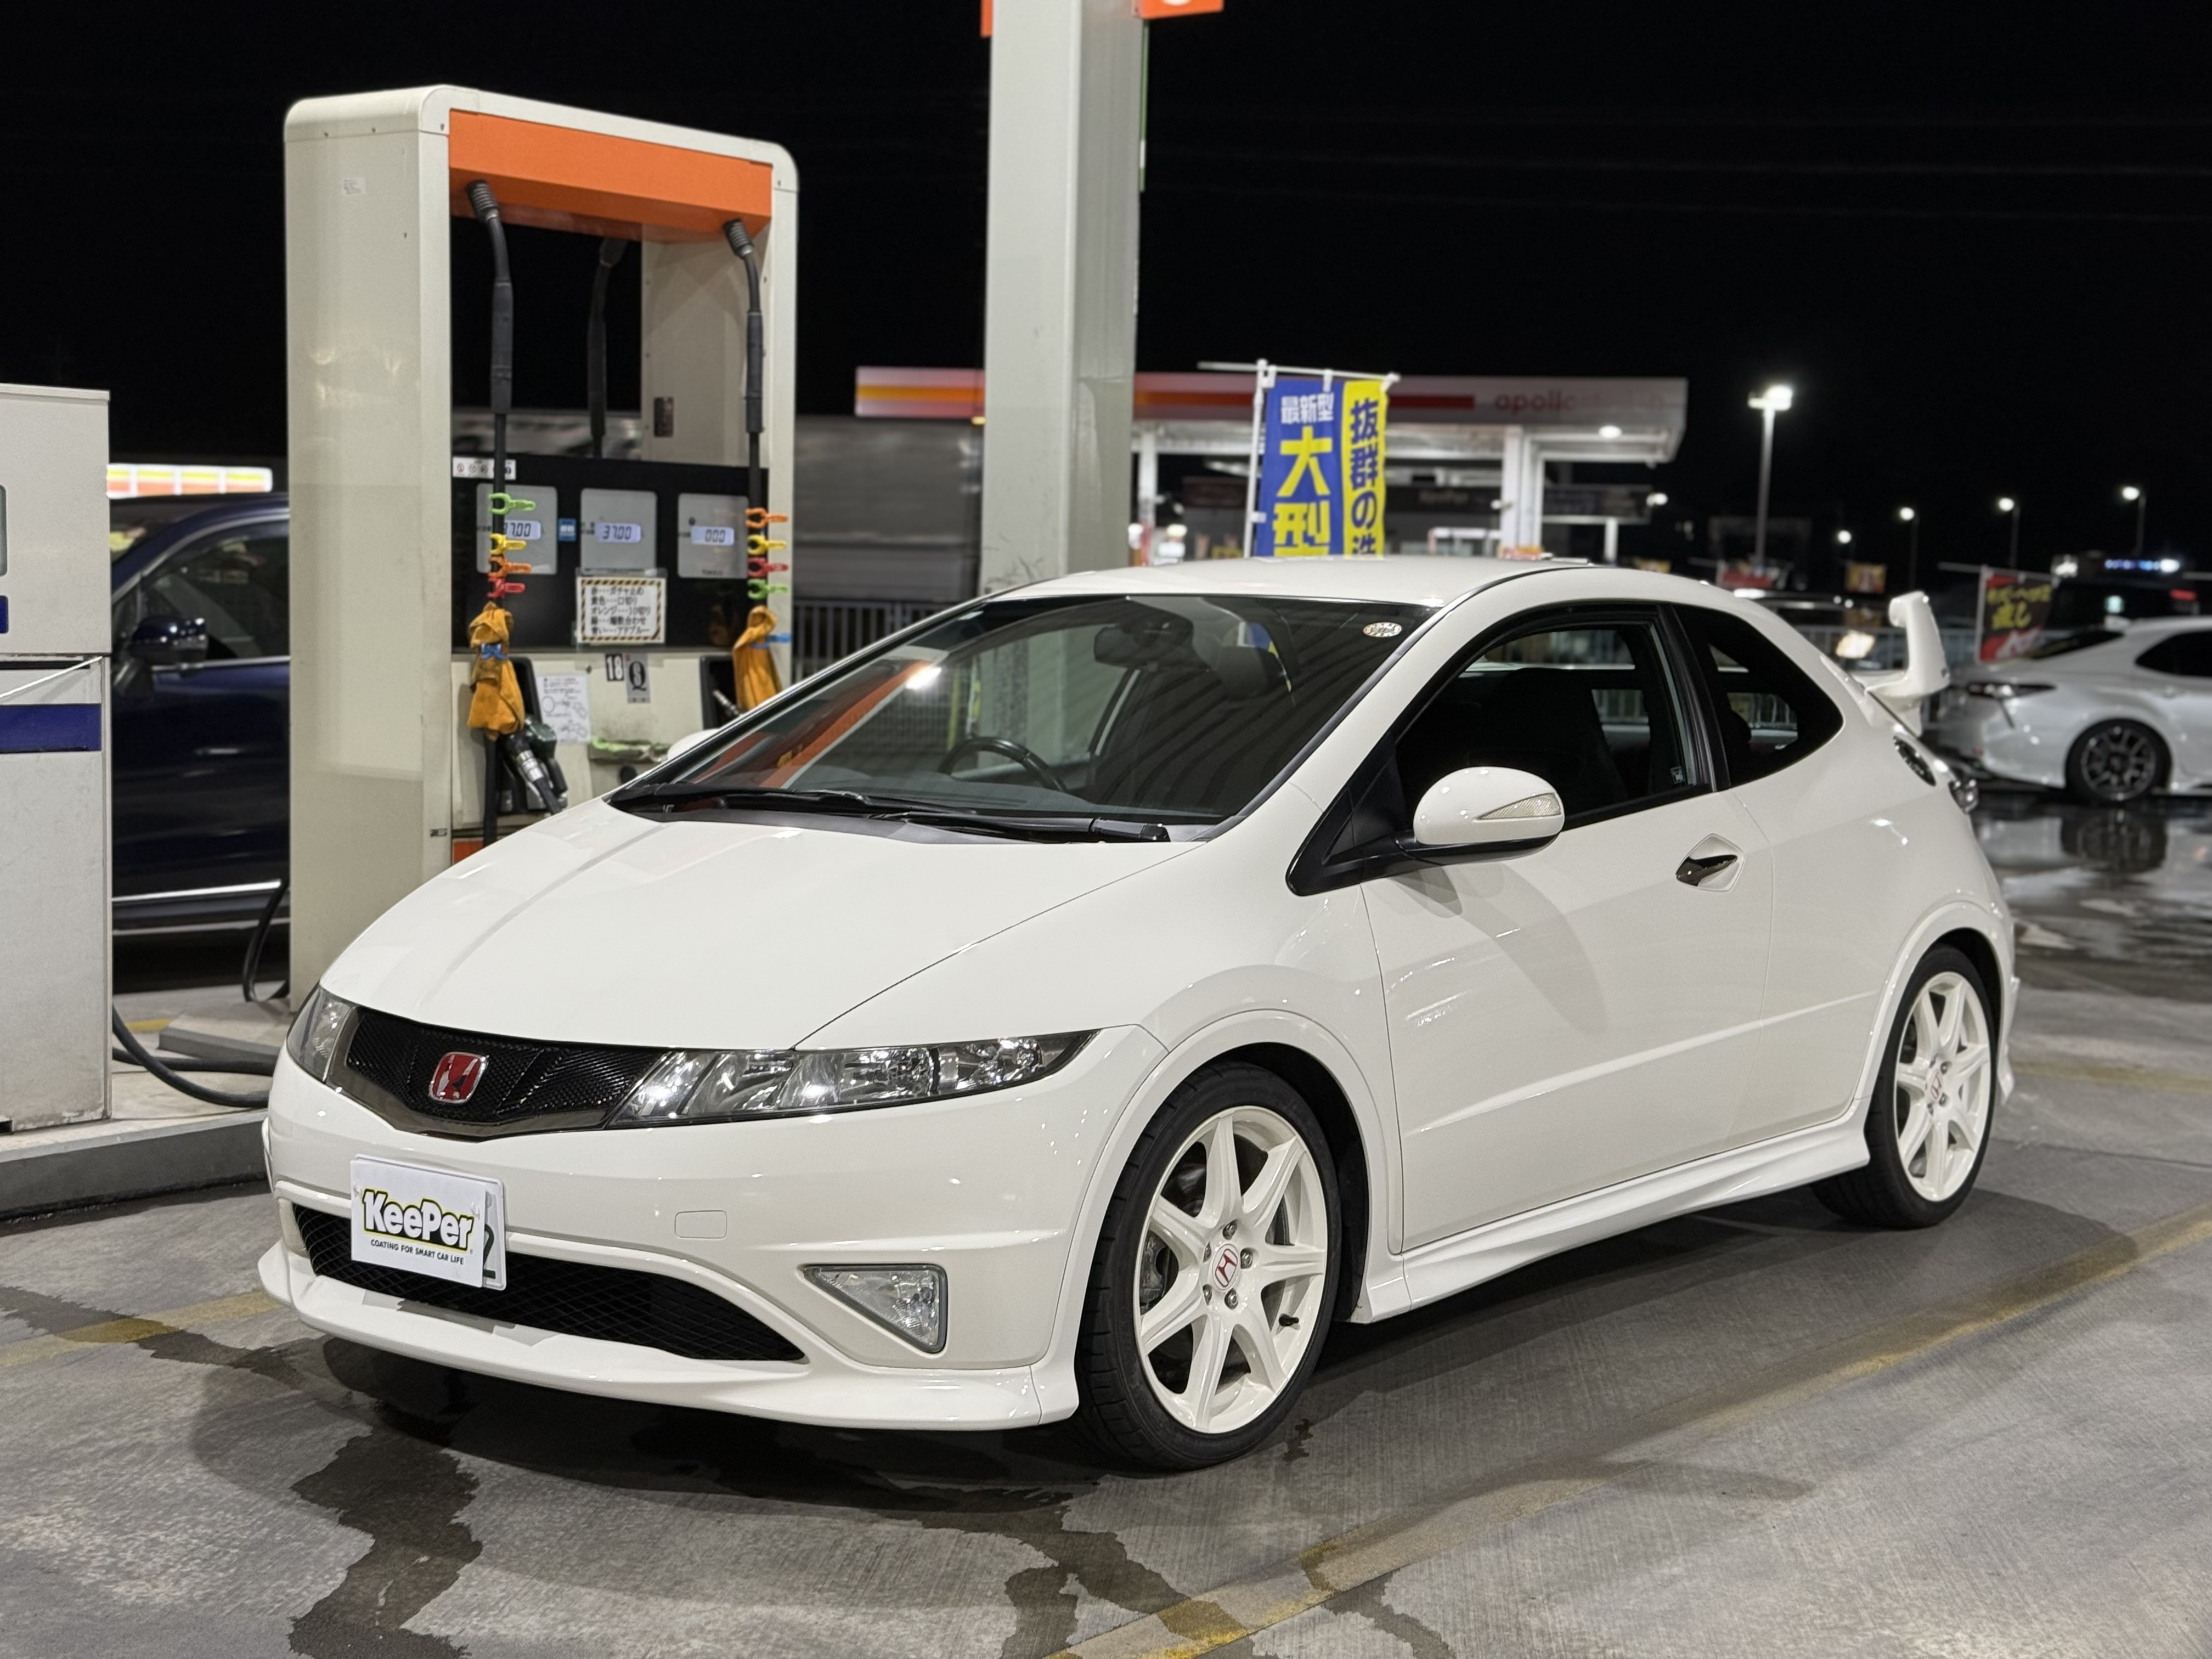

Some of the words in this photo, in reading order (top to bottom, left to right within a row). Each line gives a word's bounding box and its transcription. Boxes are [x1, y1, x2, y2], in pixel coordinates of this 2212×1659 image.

[1281, 392, 1334, 424] 最新型
[1273, 426, 1333, 557] 大型
[607, 655, 623, 680] 18
[362, 1188, 474, 1251] KeePer
[370, 1239, 399, 1250] COATING
[401, 1245, 414, 1254] FOR
[415, 1247, 436, 1259] SMART
[437, 1252, 449, 1261] CAR
[450, 1254, 464, 1265] LIFE
